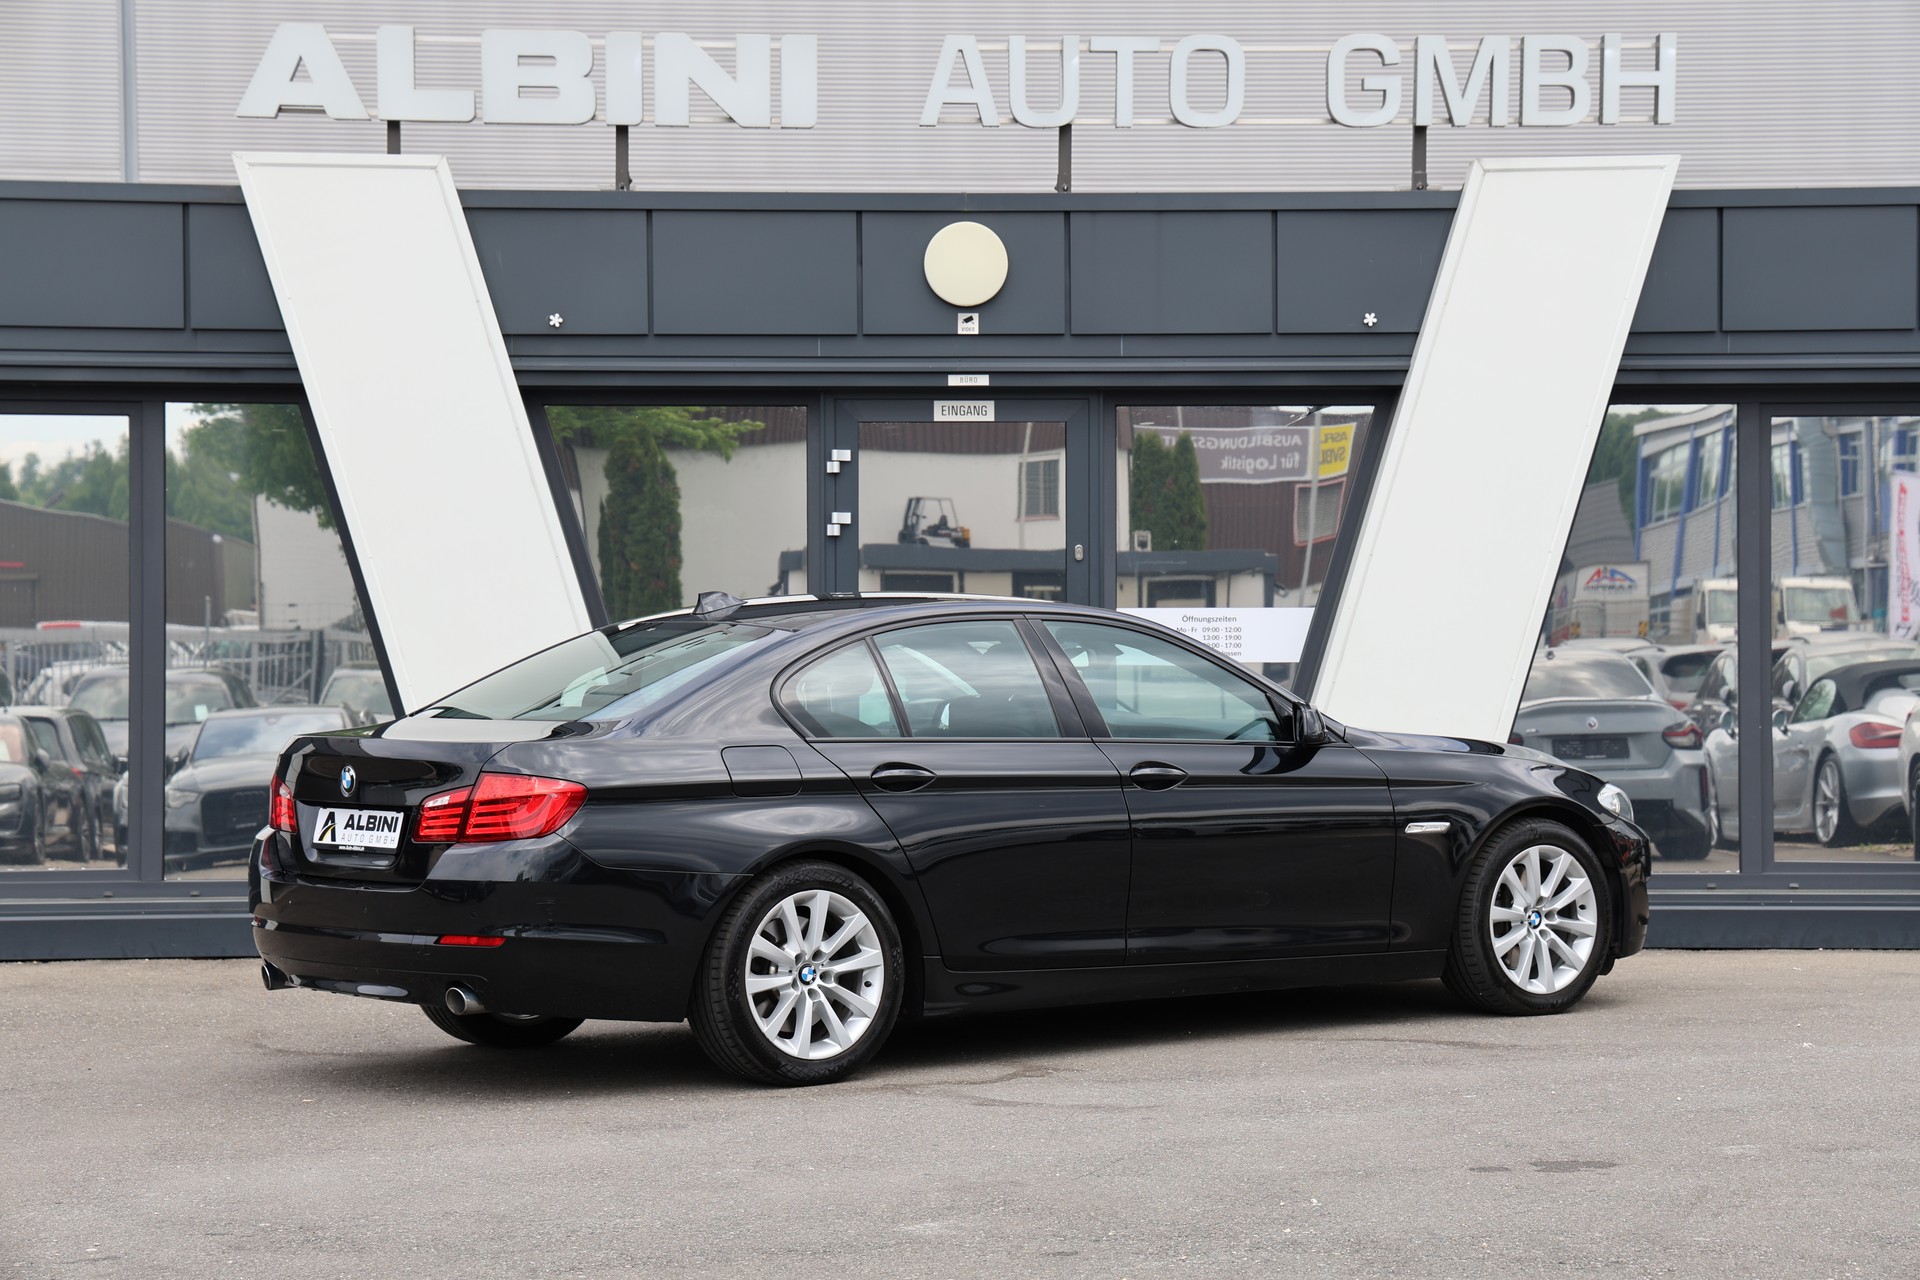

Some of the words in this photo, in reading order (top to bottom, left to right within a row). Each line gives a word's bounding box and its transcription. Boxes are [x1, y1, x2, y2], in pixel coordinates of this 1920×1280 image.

[235, 22, 818, 129] ALBINI
[919, 33, 1246, 129] AUTO
[1326, 32, 1678, 128] GMBH
[941, 405, 988, 417] EINGANG
[1181, 615, 1237, 623] Öffnungszeiten
[344, 814, 399, 833] ALBINI
[341, 833, 365, 844] AUTO
[368, 835, 396, 845] GMBH
